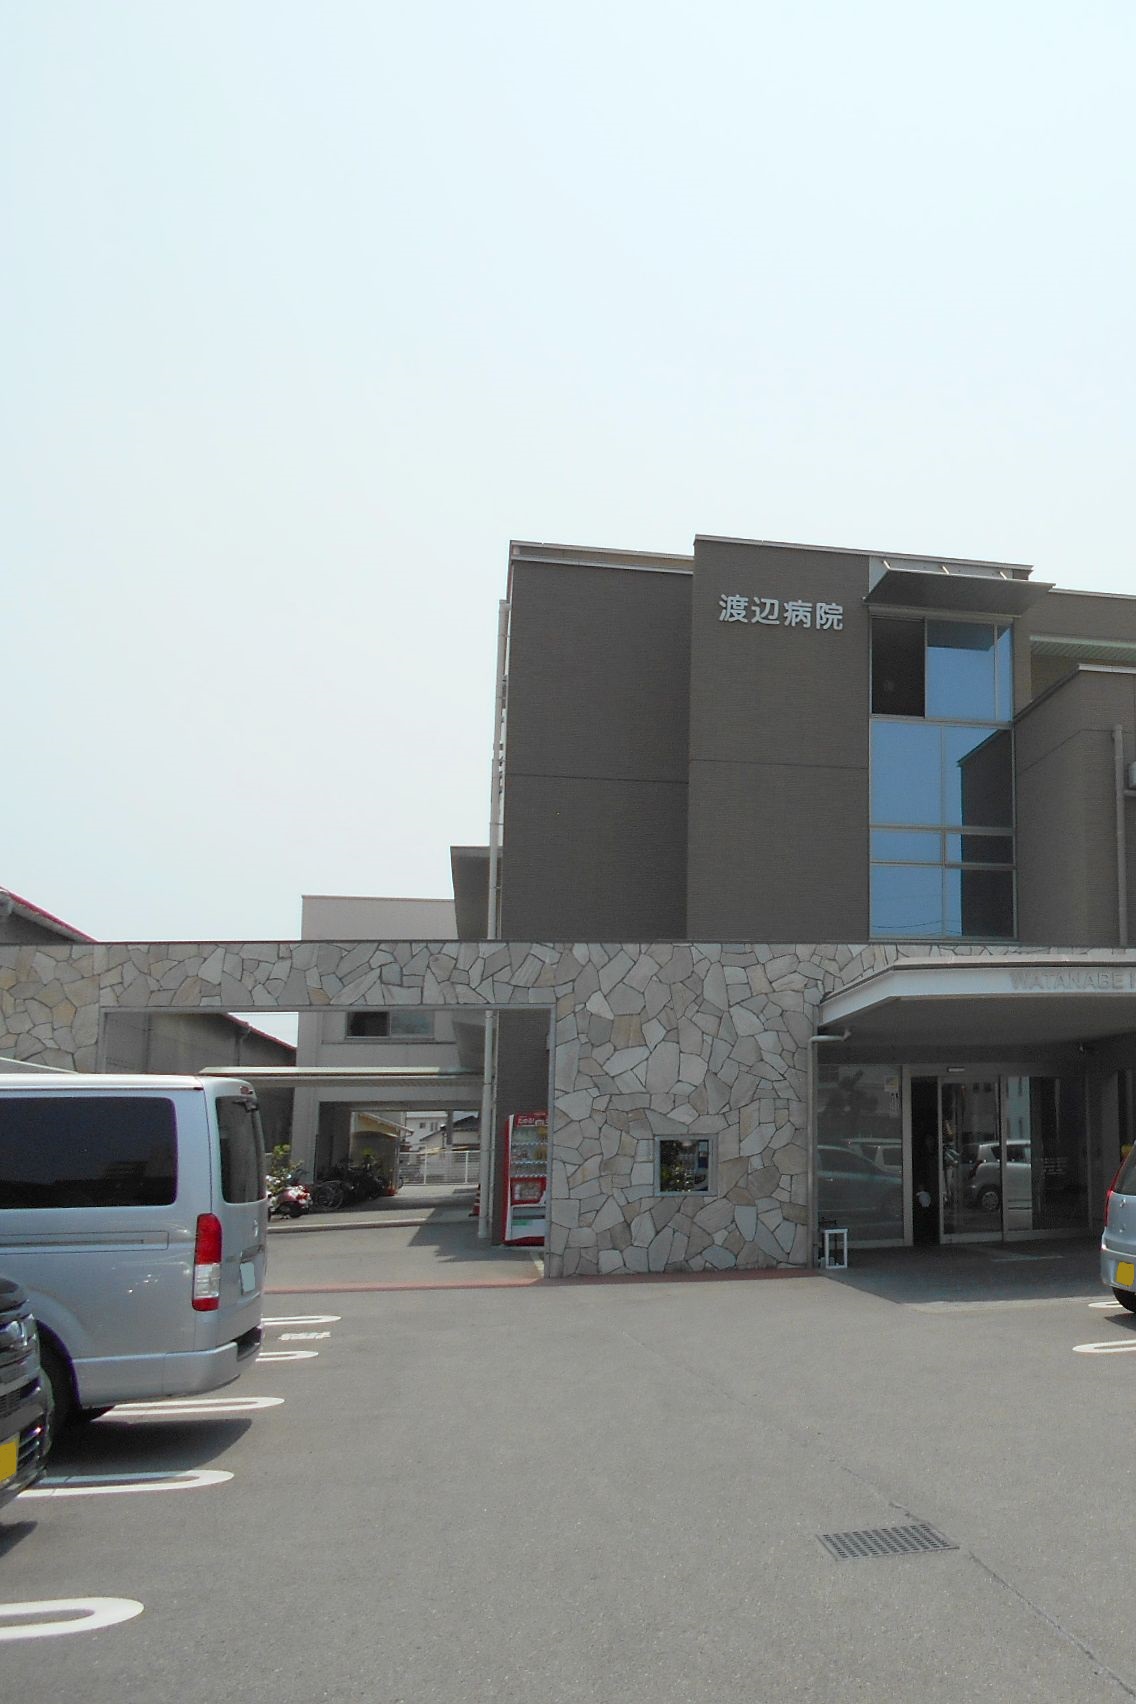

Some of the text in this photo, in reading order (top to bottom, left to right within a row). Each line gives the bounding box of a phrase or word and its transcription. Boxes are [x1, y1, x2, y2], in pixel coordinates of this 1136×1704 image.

[718, 593, 844, 631] 渡辺病院
[1009, 971, 1124, 990] WATANABE
